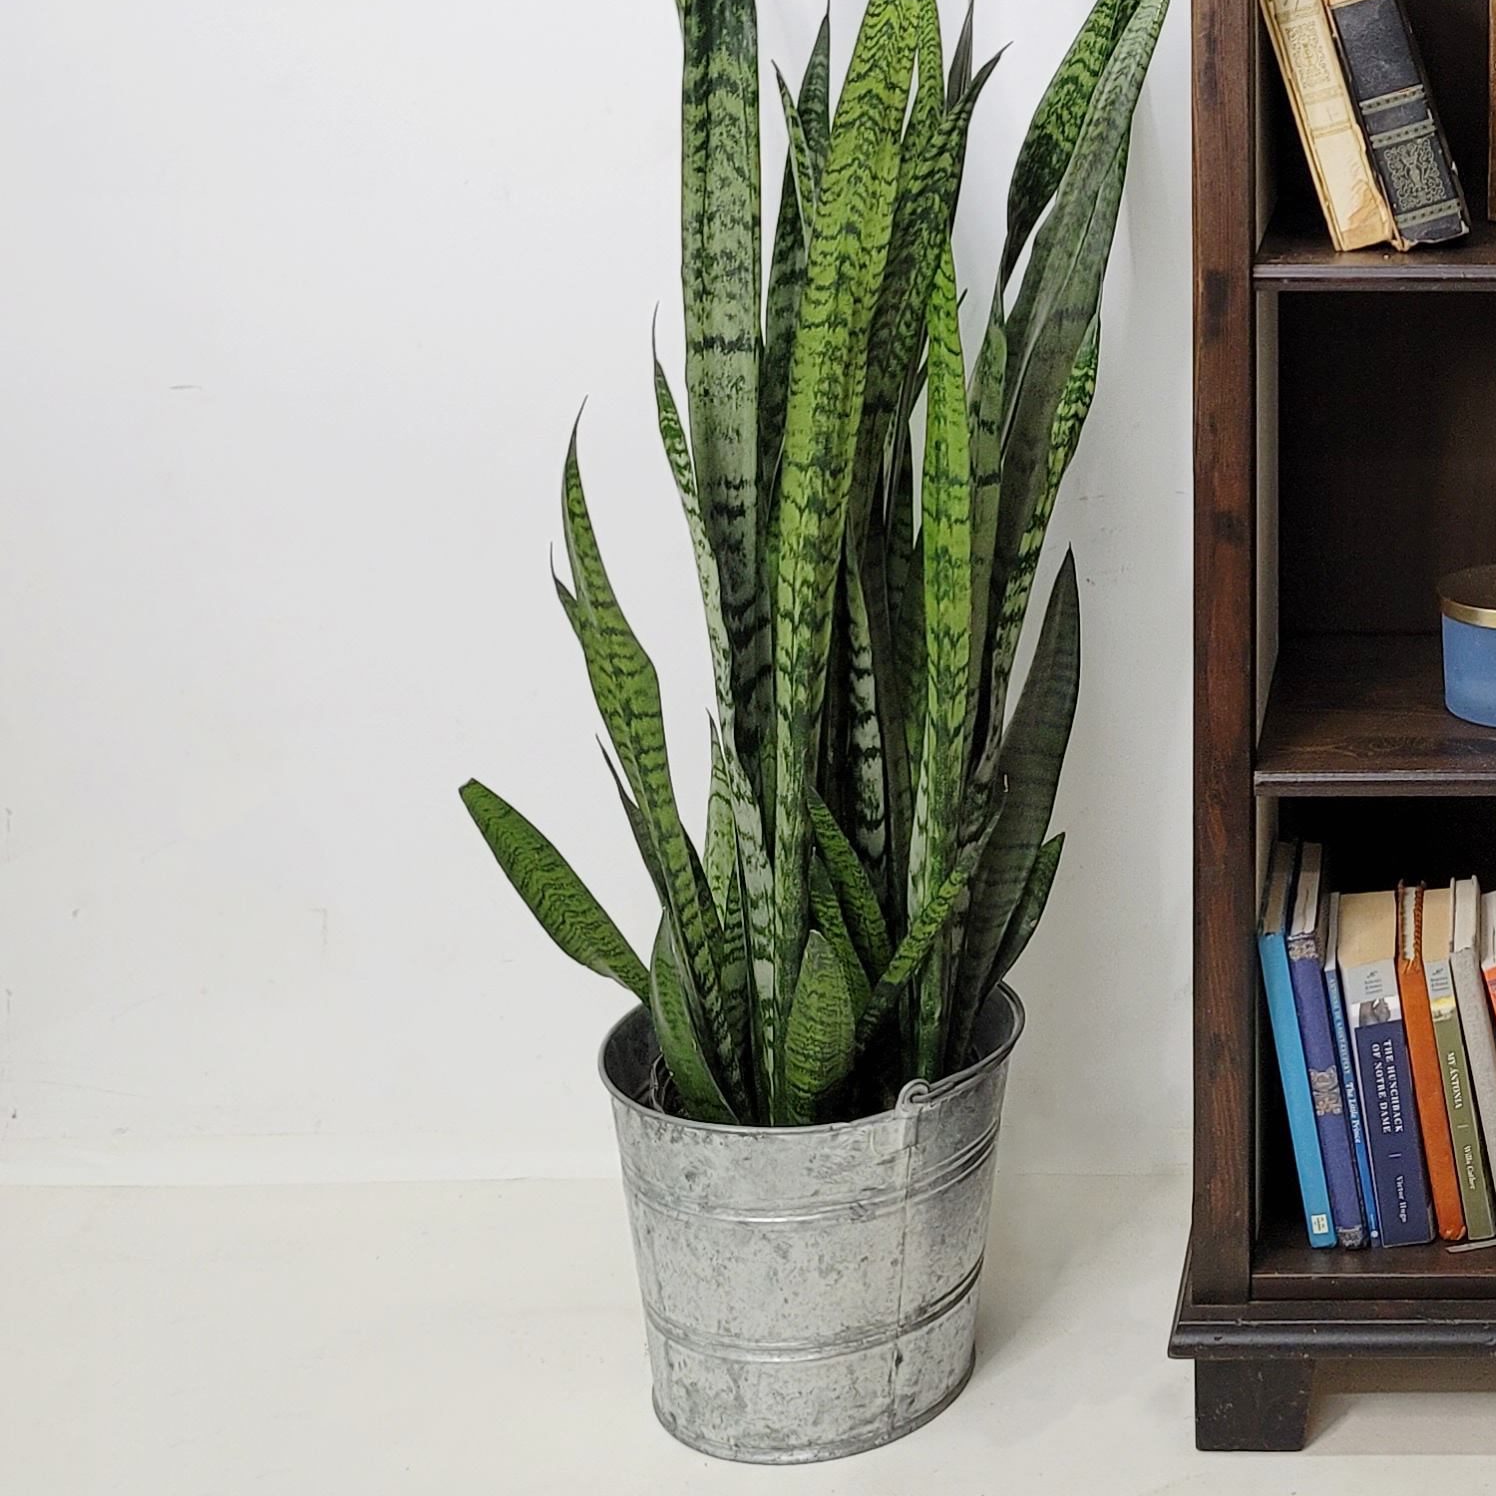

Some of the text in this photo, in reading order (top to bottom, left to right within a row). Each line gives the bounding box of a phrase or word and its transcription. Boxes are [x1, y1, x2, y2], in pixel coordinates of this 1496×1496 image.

[1371, 1043, 1392, 1134] OF NOTRE DAME
[1383, 1039, 1403, 1133] THE HUNCHBACK
